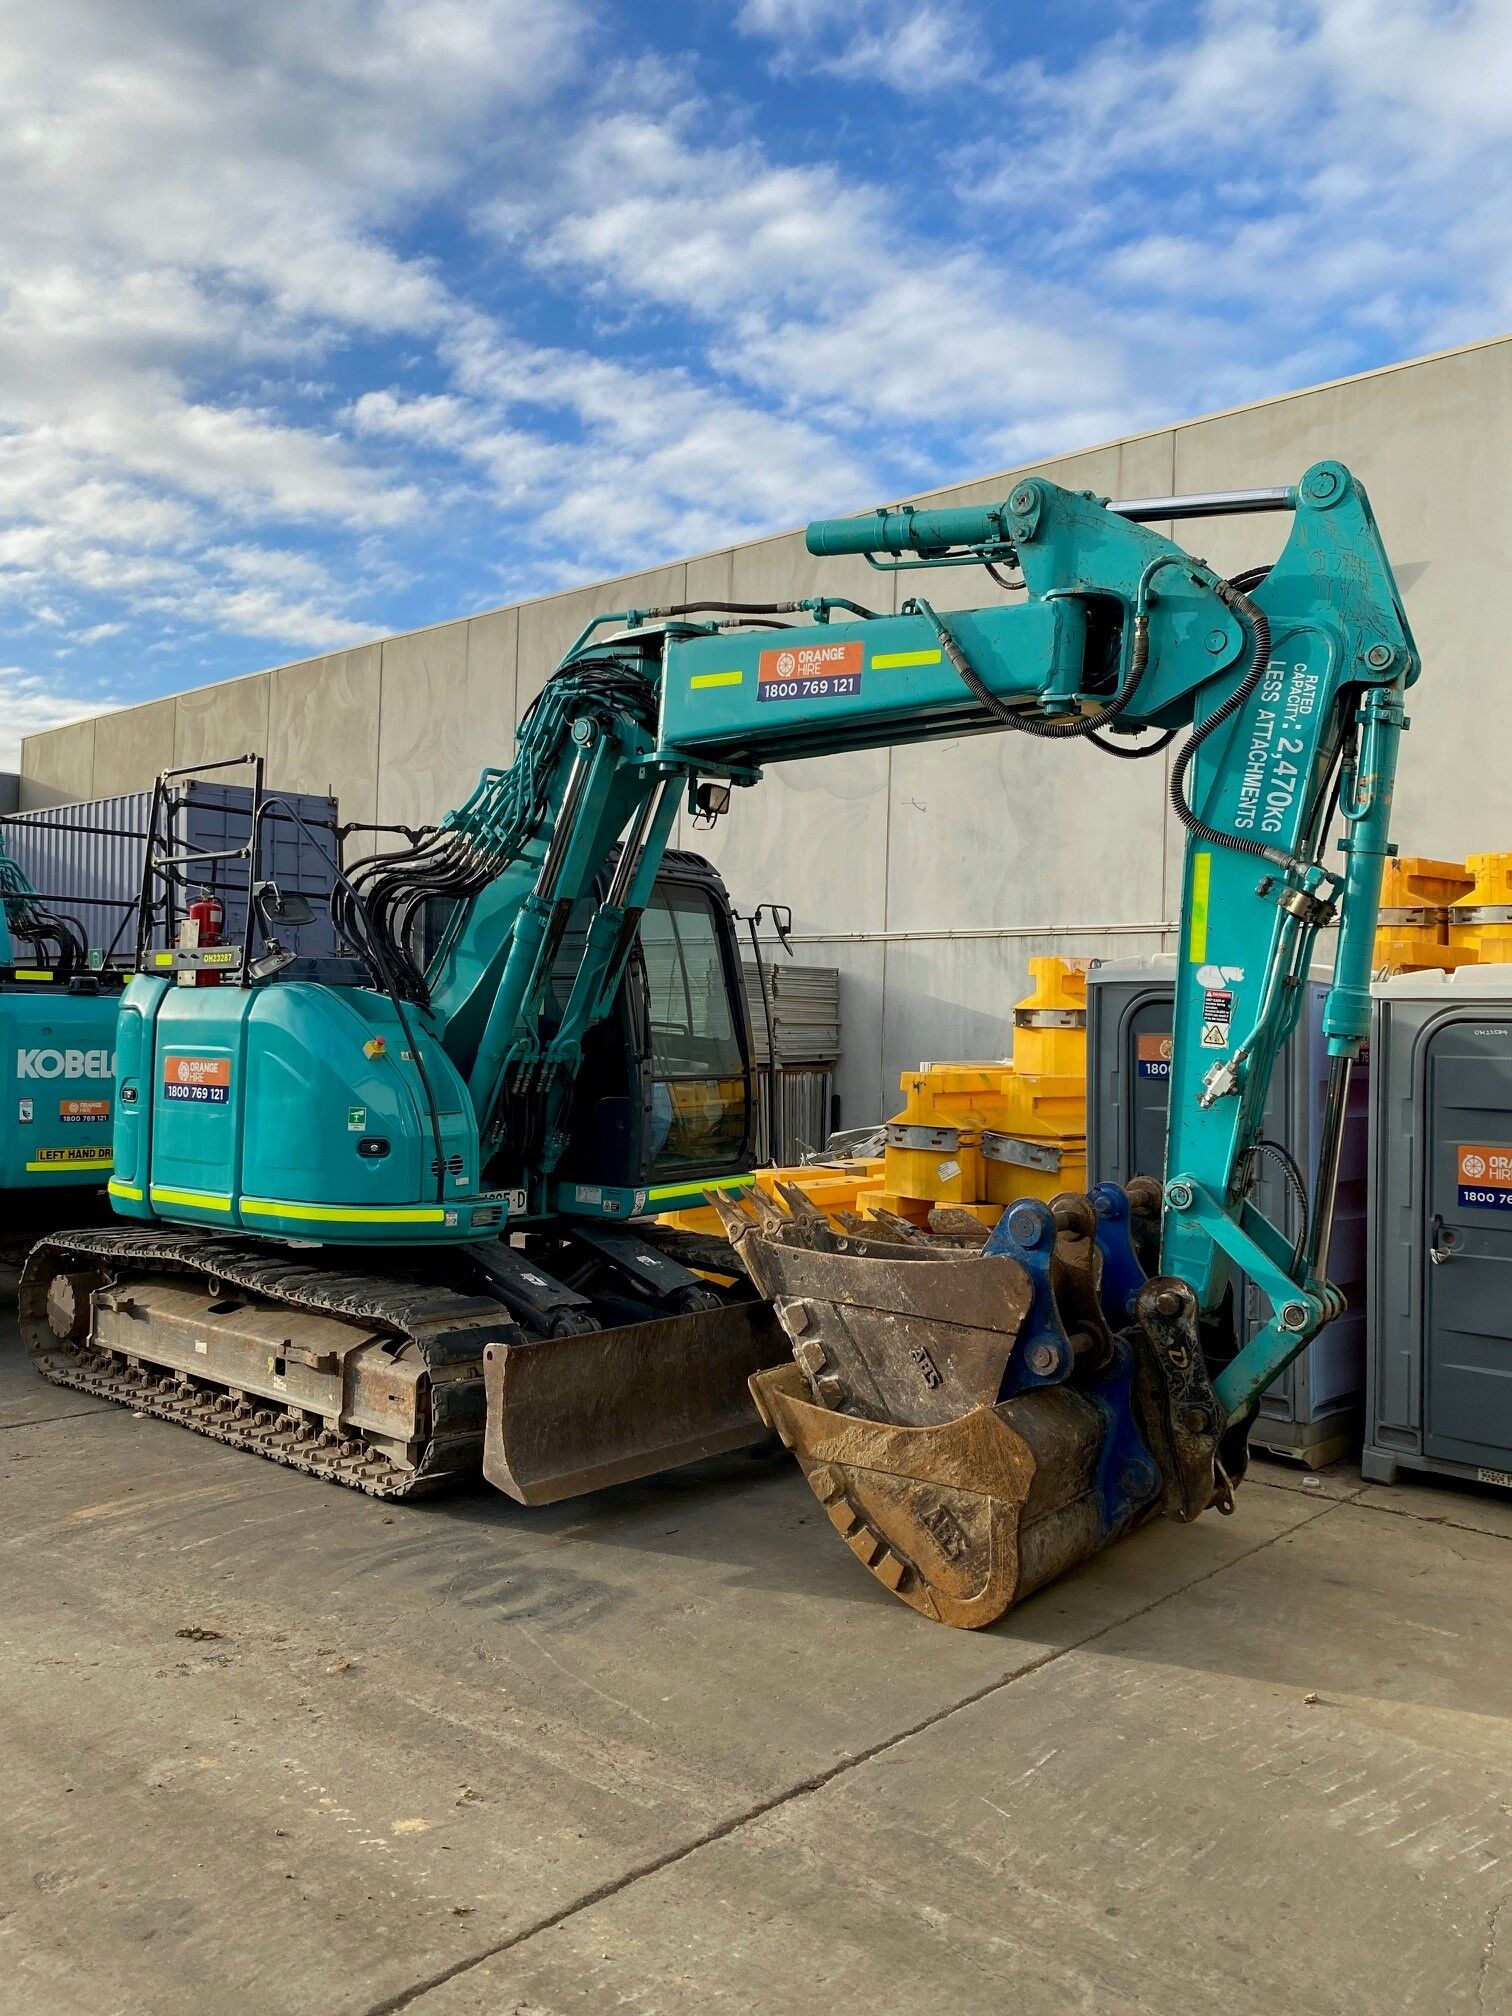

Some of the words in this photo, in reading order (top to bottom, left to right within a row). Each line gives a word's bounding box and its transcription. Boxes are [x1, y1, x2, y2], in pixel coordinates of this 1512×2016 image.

[798, 647, 846, 663] ORANGE
[797, 662, 822, 676] HIRE
[764, 683, 798, 698] 1800
[803, 680, 828, 695] 769
[833, 677, 854, 692] 121
[1260, 660, 1287, 703] LESS
[1299, 675, 1319, 715] RATED
[1234, 708, 1276, 829] ATTACHMENTS
[1261, 737, 1304, 833] 2,470KG
[17, 1049, 118, 1079] KOBEL
[189, 1061, 219, 1074] ORANGE
[1145, 1063, 1171, 1075] 180
[189, 1072, 205, 1083] HIRE
[168, 1085, 189, 1098] 1800
[191, 1086, 208, 1099] 769
[210, 1088, 224, 1100] 121
[39, 1150, 65, 1160] LEFT
[67, 1149, 96, 1159] HAND
[1463, 1191, 1495, 1203] 1800
[909, 1347, 941, 1390] ABS
